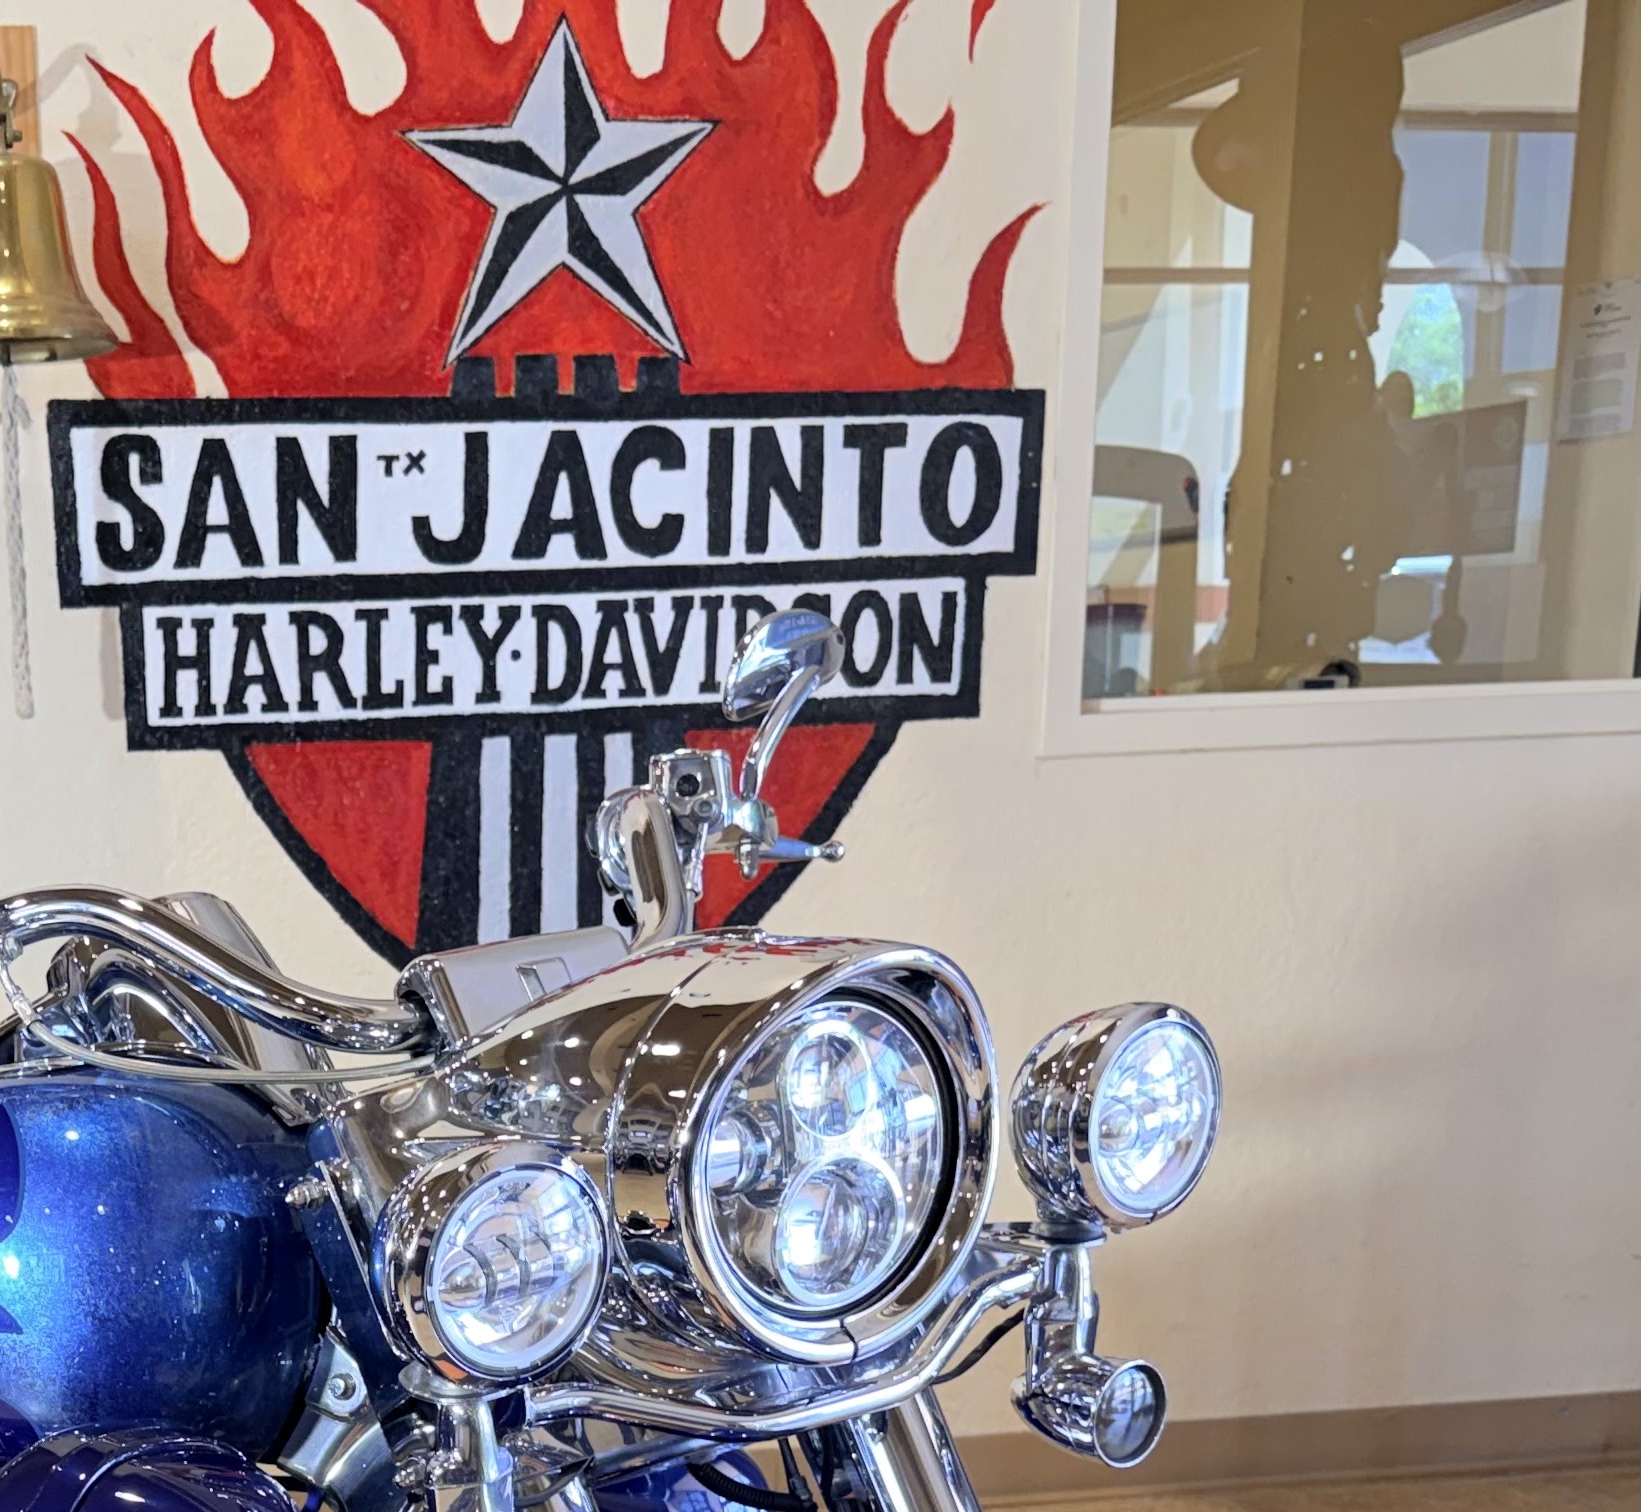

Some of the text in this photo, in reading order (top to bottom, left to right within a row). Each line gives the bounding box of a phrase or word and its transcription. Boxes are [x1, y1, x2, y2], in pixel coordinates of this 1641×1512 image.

[95, 421, 1003, 573] SAN TX JACINTO
